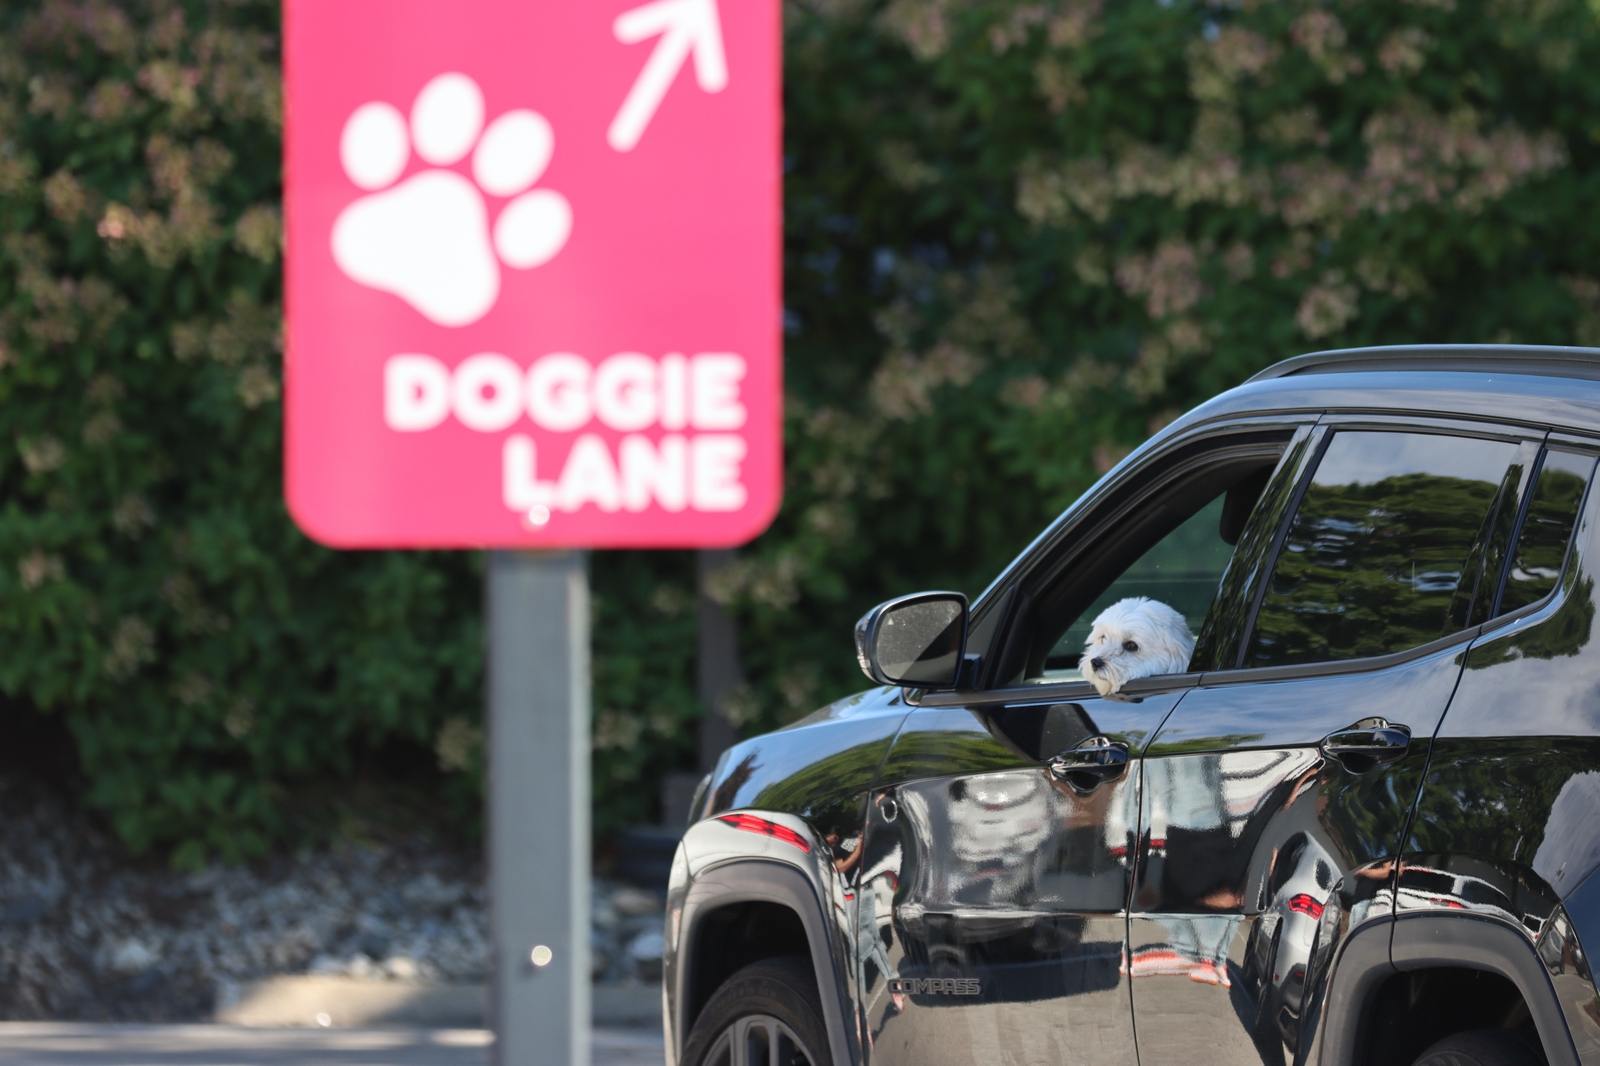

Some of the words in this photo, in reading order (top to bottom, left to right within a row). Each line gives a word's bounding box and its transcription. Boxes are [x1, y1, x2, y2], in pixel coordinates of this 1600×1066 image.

[383, 353, 746, 431] DOGGIE
[502, 434, 746, 512] LANE
[887, 978, 980, 995] COMPASS
